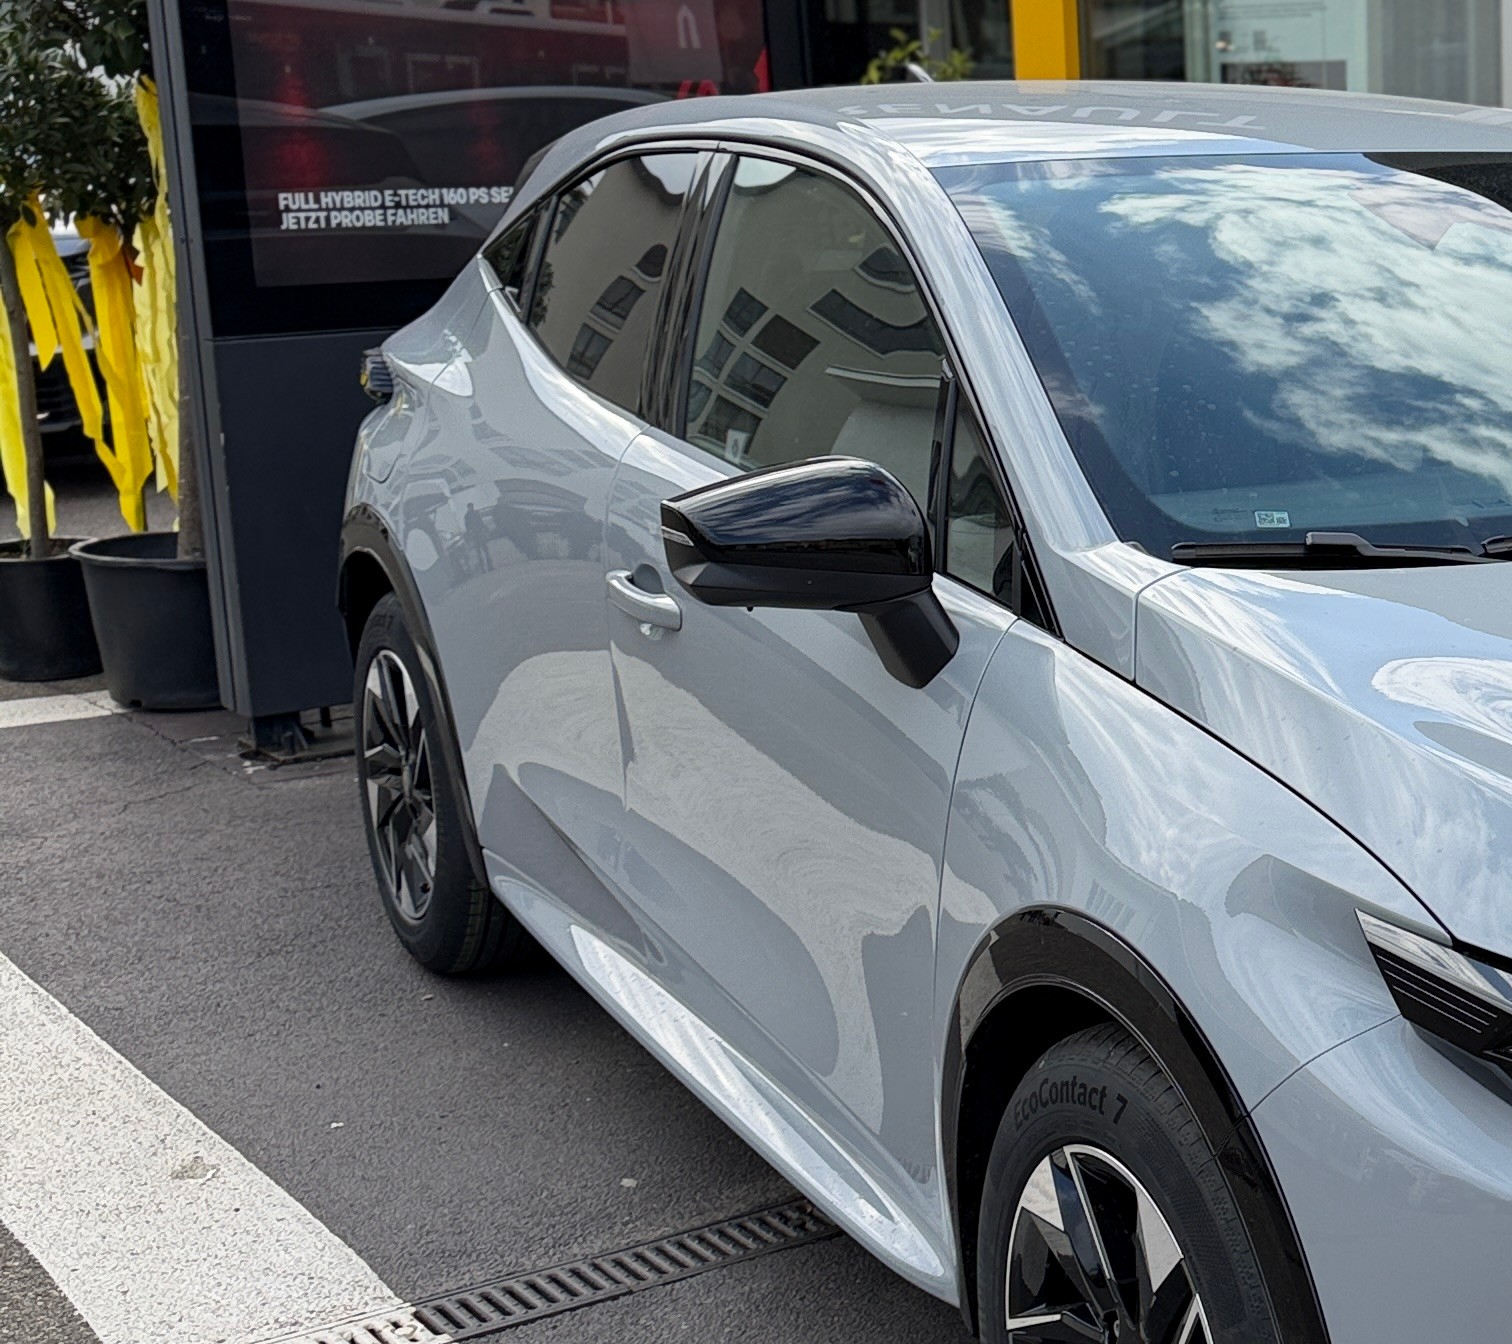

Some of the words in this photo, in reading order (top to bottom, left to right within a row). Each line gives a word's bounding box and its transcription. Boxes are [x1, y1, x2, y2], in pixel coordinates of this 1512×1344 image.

[277, 192, 320, 211] FULL
[321, 189, 382, 209] HYBRID
[384, 188, 440, 207] E-TECH
[442, 187, 467, 205] 160
[469, 187, 489, 204] PS
[279, 211, 328, 230] JETZT
[330, 209, 385, 228] PROBE
[387, 207, 449, 226] FAHREN
[1013, 1075, 1108, 1131] EcoContact
[1113, 1093, 1129, 1126] 7
